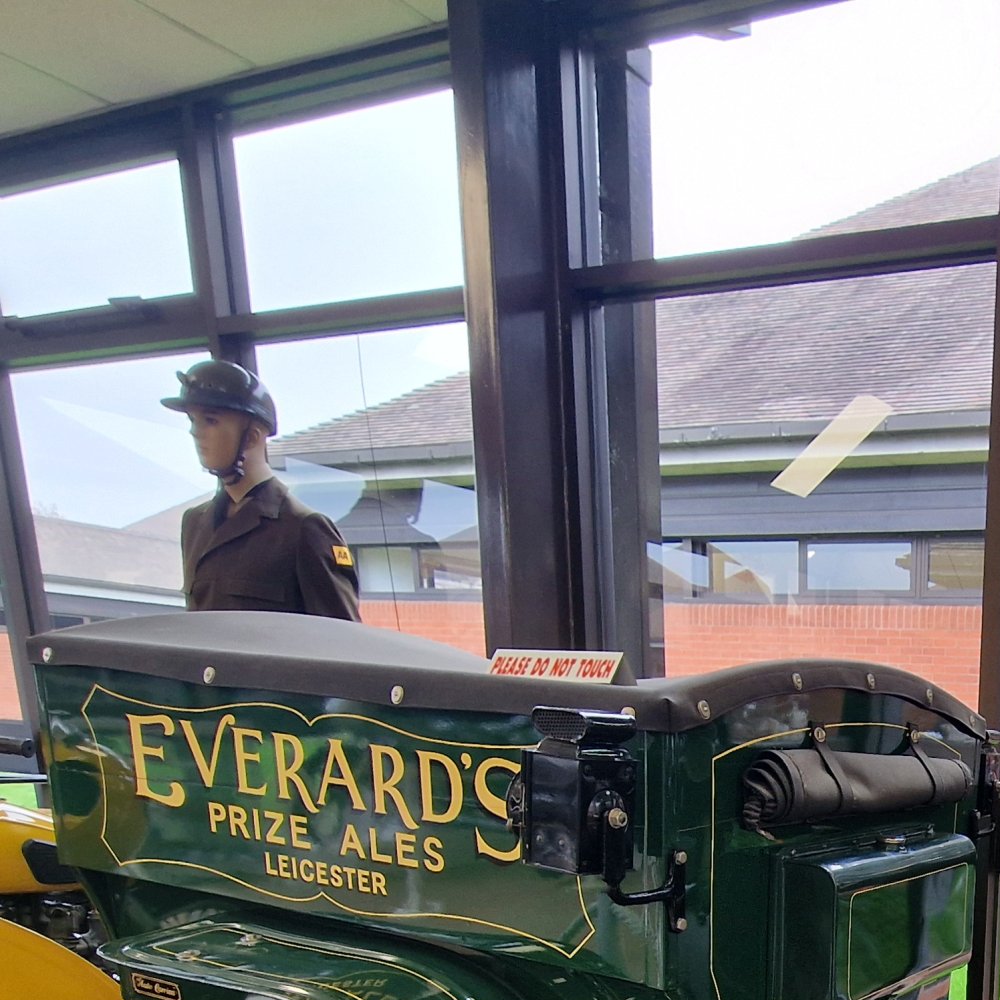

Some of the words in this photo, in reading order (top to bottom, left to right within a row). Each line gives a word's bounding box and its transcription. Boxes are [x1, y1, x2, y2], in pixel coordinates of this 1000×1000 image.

[337, 550, 349, 560] AA
[490, 656, 532, 675] PLEASE
[530, 657, 550, 676] DO
[550, 658, 577, 677] NOT
[576, 659, 616, 678] TOUCH
[126, 713, 522, 862] EVERARD'S
[208, 801, 312, 850] PRIZE
[339, 823, 445, 873] ALES
[264, 851, 388, 896] LEICESTER
